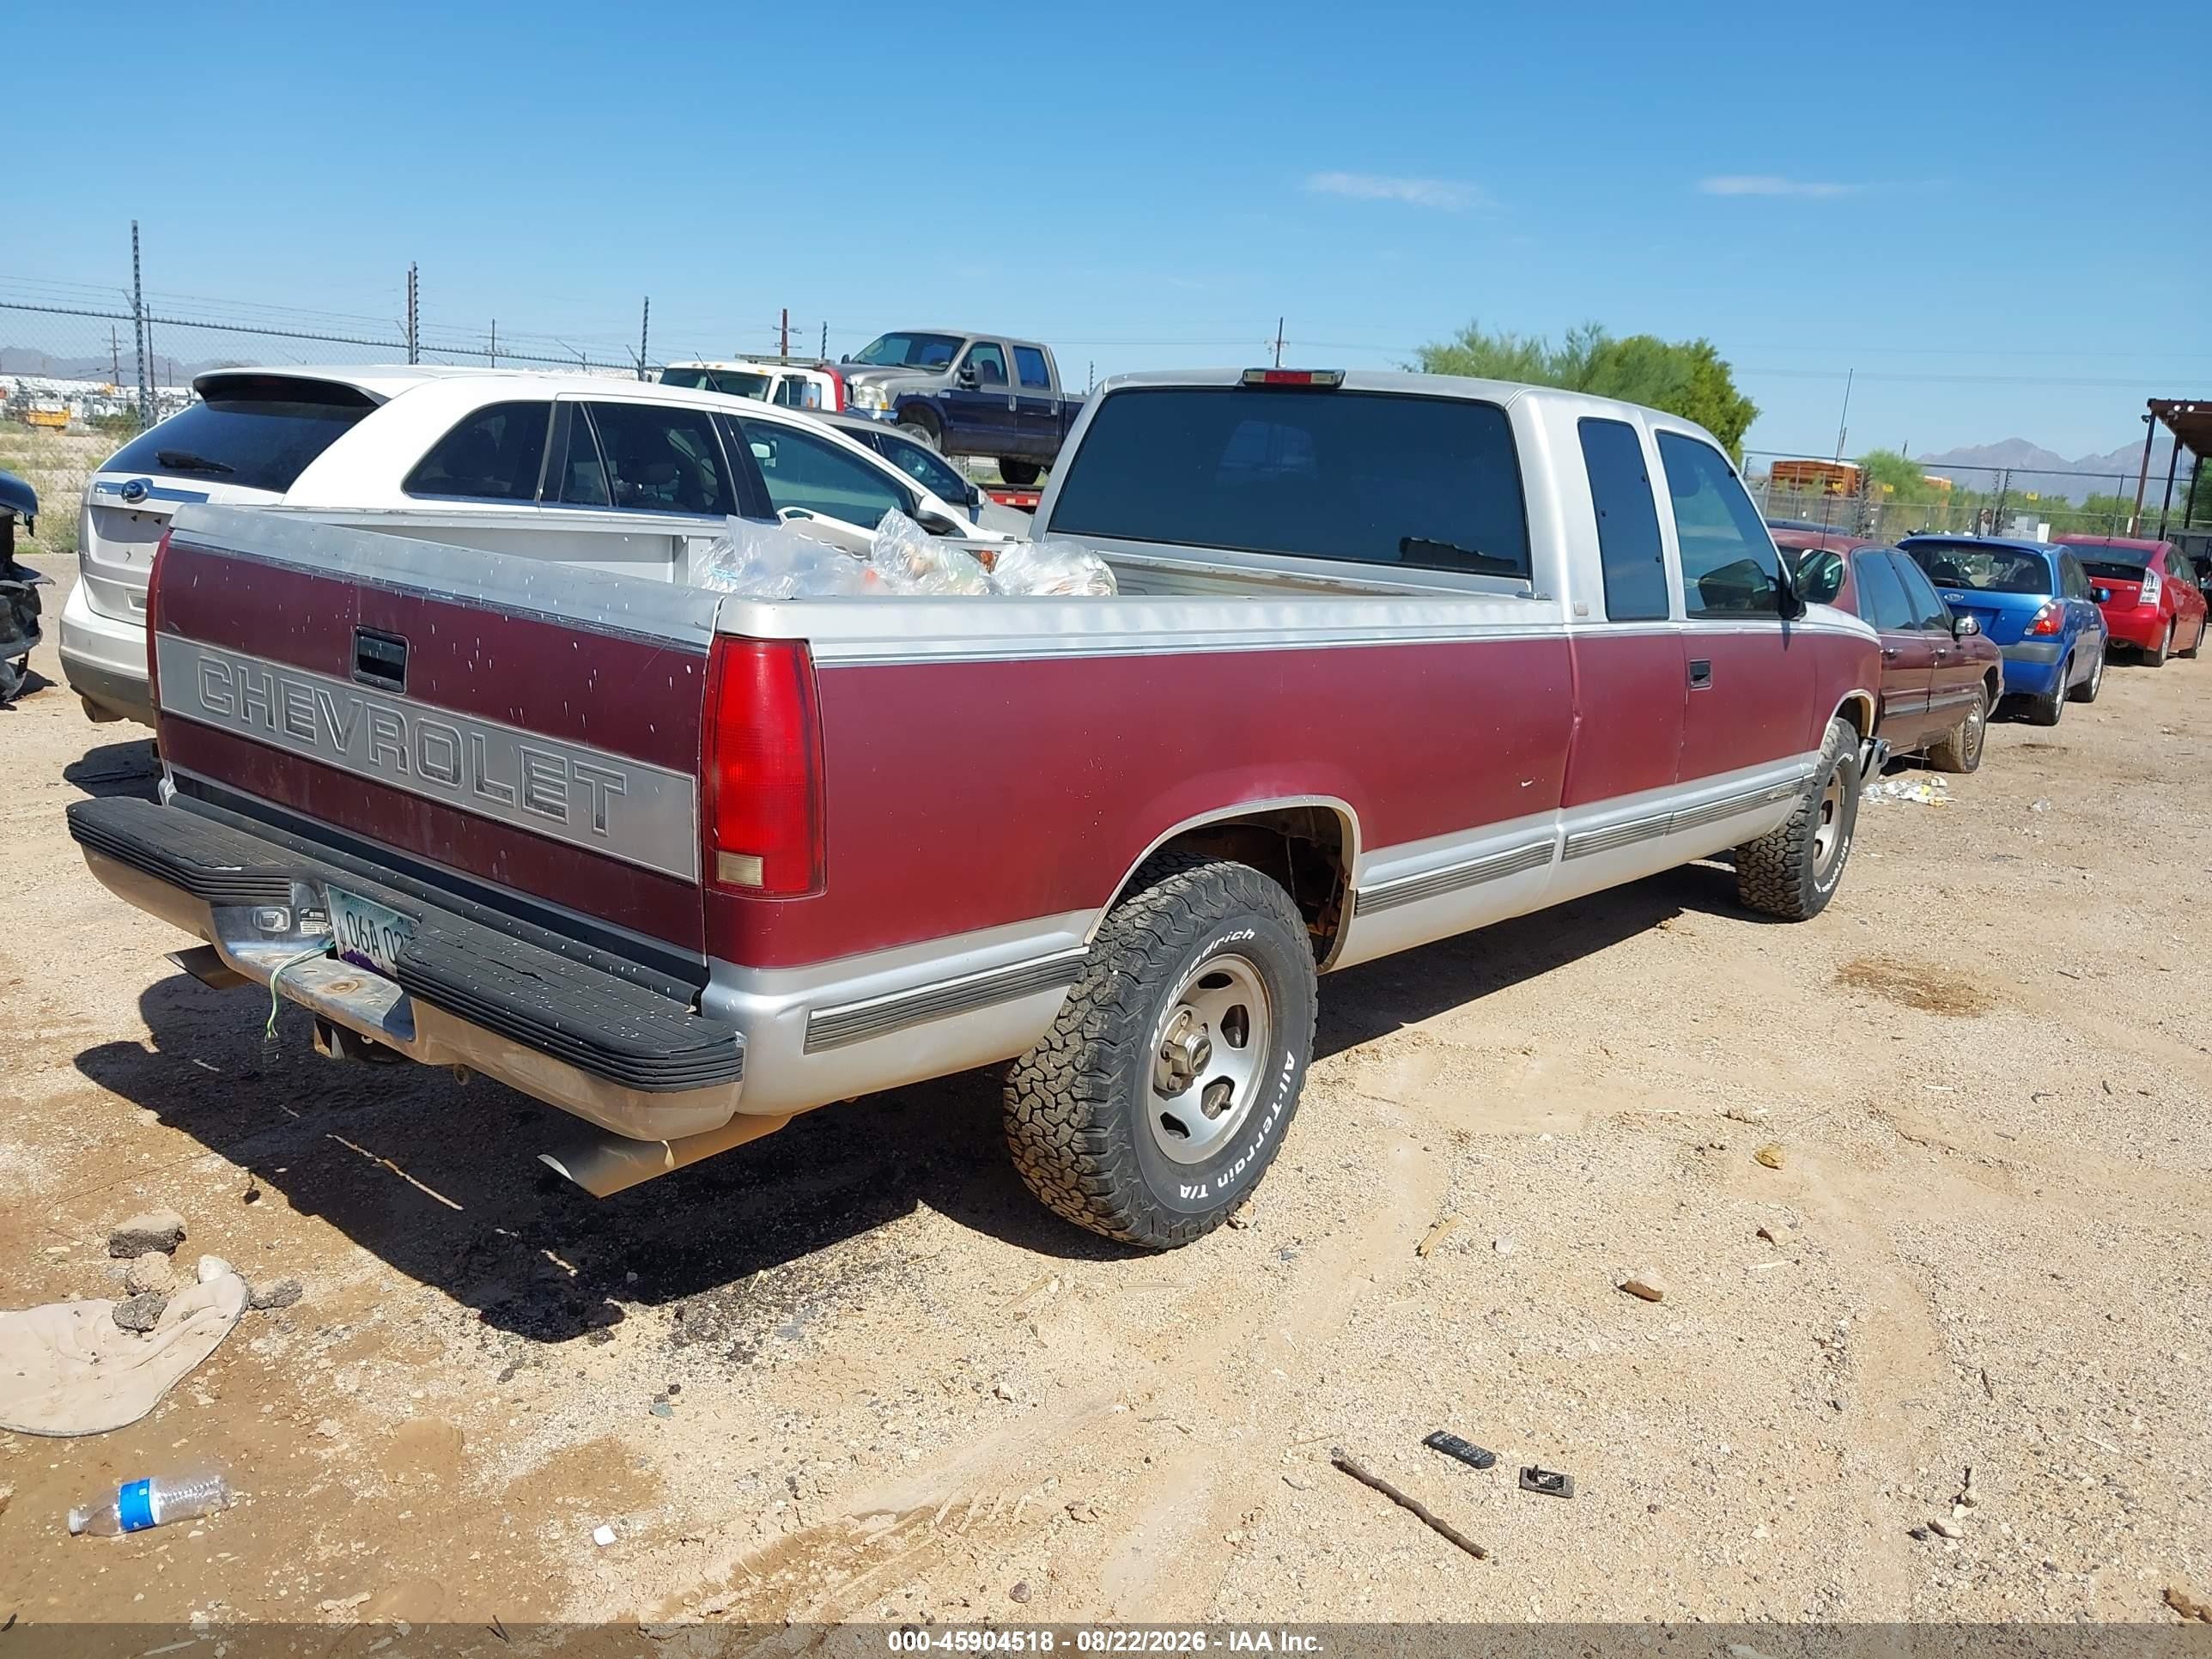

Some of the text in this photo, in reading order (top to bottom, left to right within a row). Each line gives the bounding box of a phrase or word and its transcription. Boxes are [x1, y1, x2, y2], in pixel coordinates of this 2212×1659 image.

[198, 656, 627, 837] CHEVROLET
[346, 910, 382, 959] 06A
[383, 927, 416, 964] 02
[1180, 1051, 1295, 1200] All-Terrain T/A
